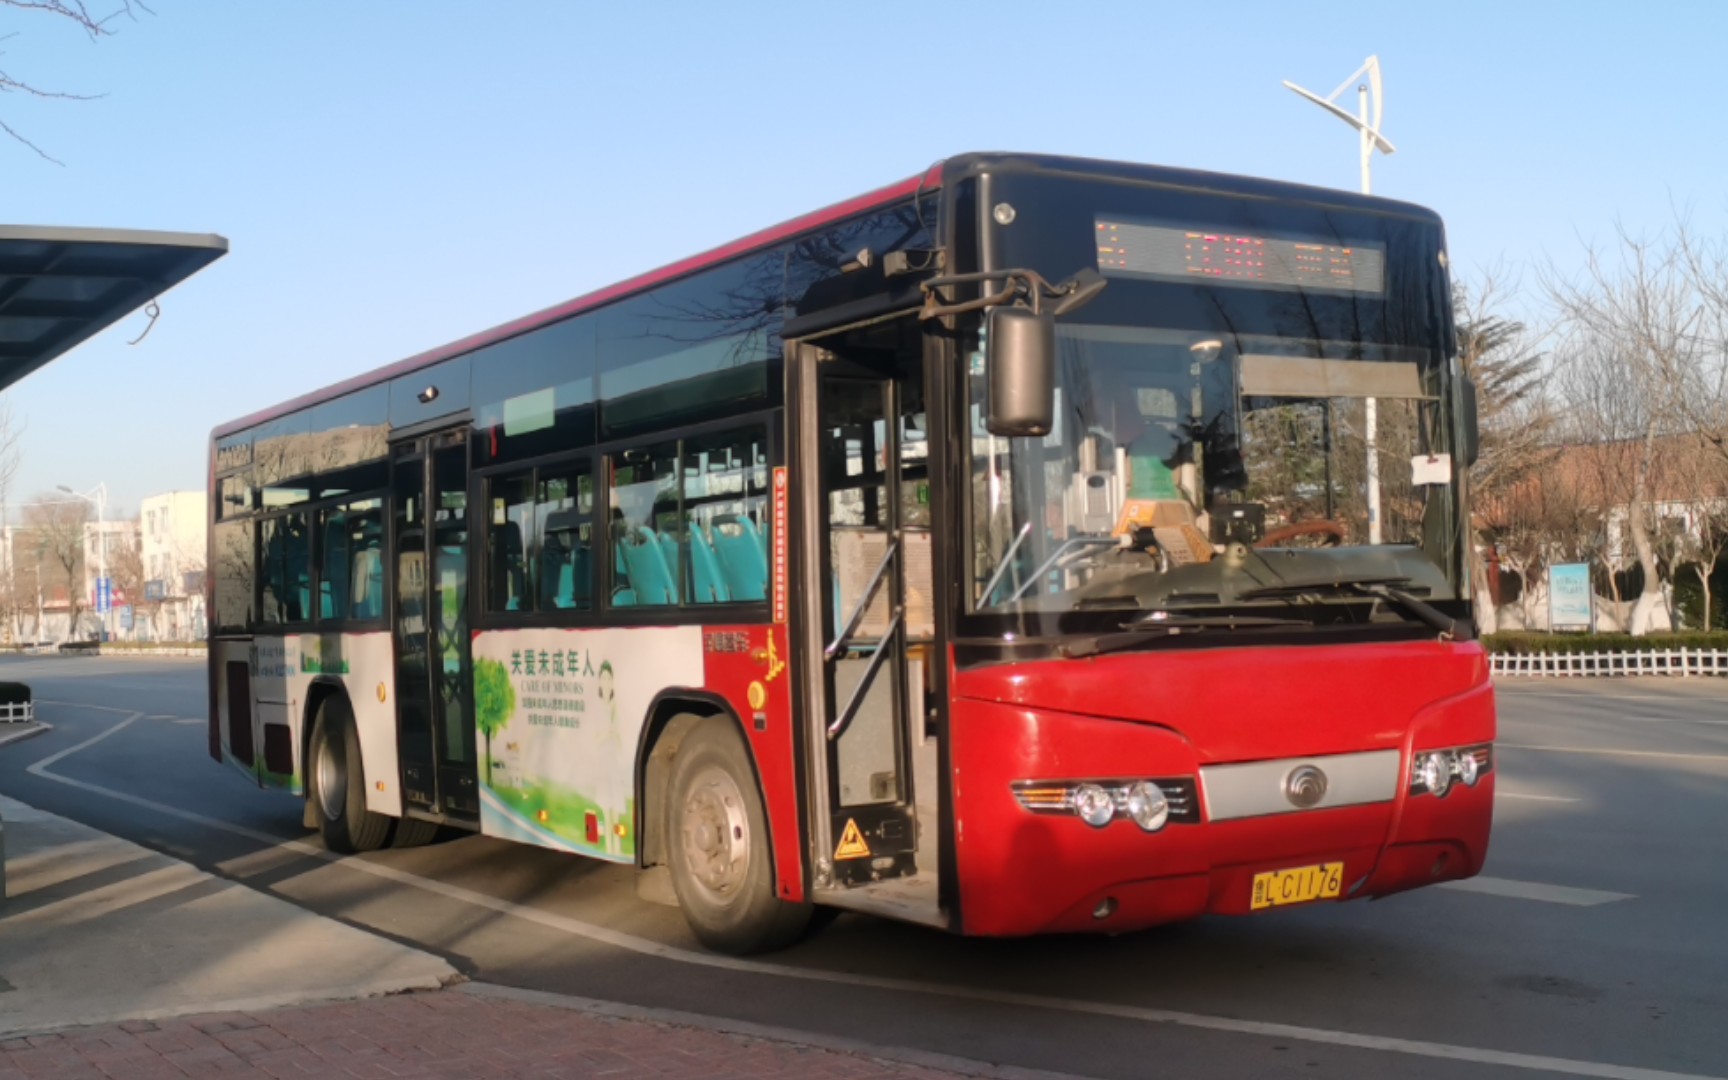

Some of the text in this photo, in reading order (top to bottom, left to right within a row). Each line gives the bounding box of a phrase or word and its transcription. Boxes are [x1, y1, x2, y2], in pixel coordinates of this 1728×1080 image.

[511, 649, 594, 676] 关爱未成年人
[521, 679, 540, 692] CARE
[541, 680, 551, 693] OF
